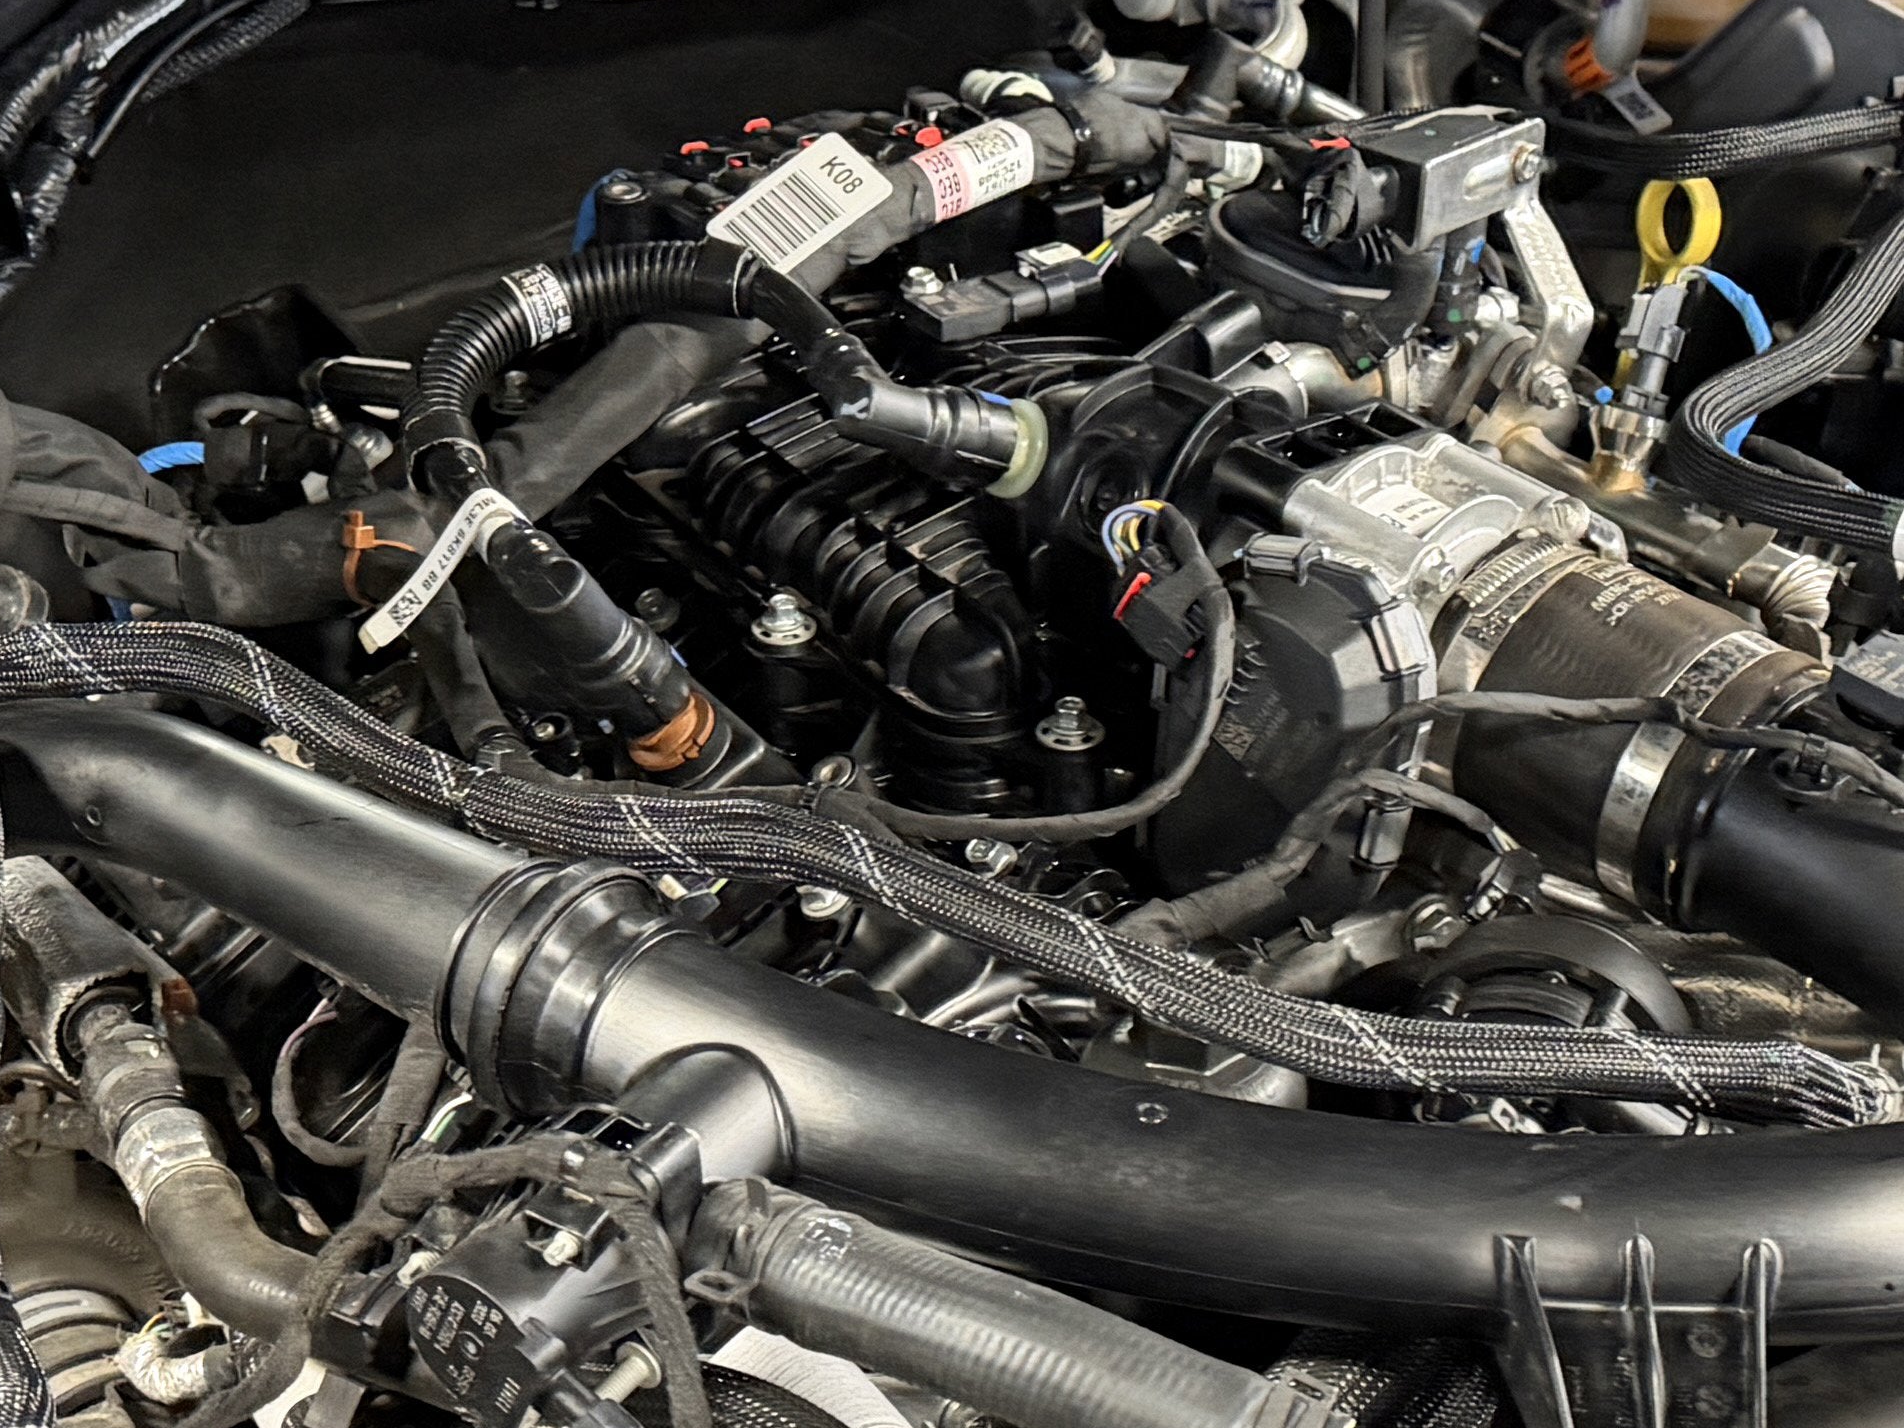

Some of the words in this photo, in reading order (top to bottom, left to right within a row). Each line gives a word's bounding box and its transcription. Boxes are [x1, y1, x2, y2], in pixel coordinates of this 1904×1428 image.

[819, 155, 863, 194] K08
[925, 151, 954, 174] BEC
[938, 172, 961, 199] BEC
[465, 496, 497, 528] ML3E
